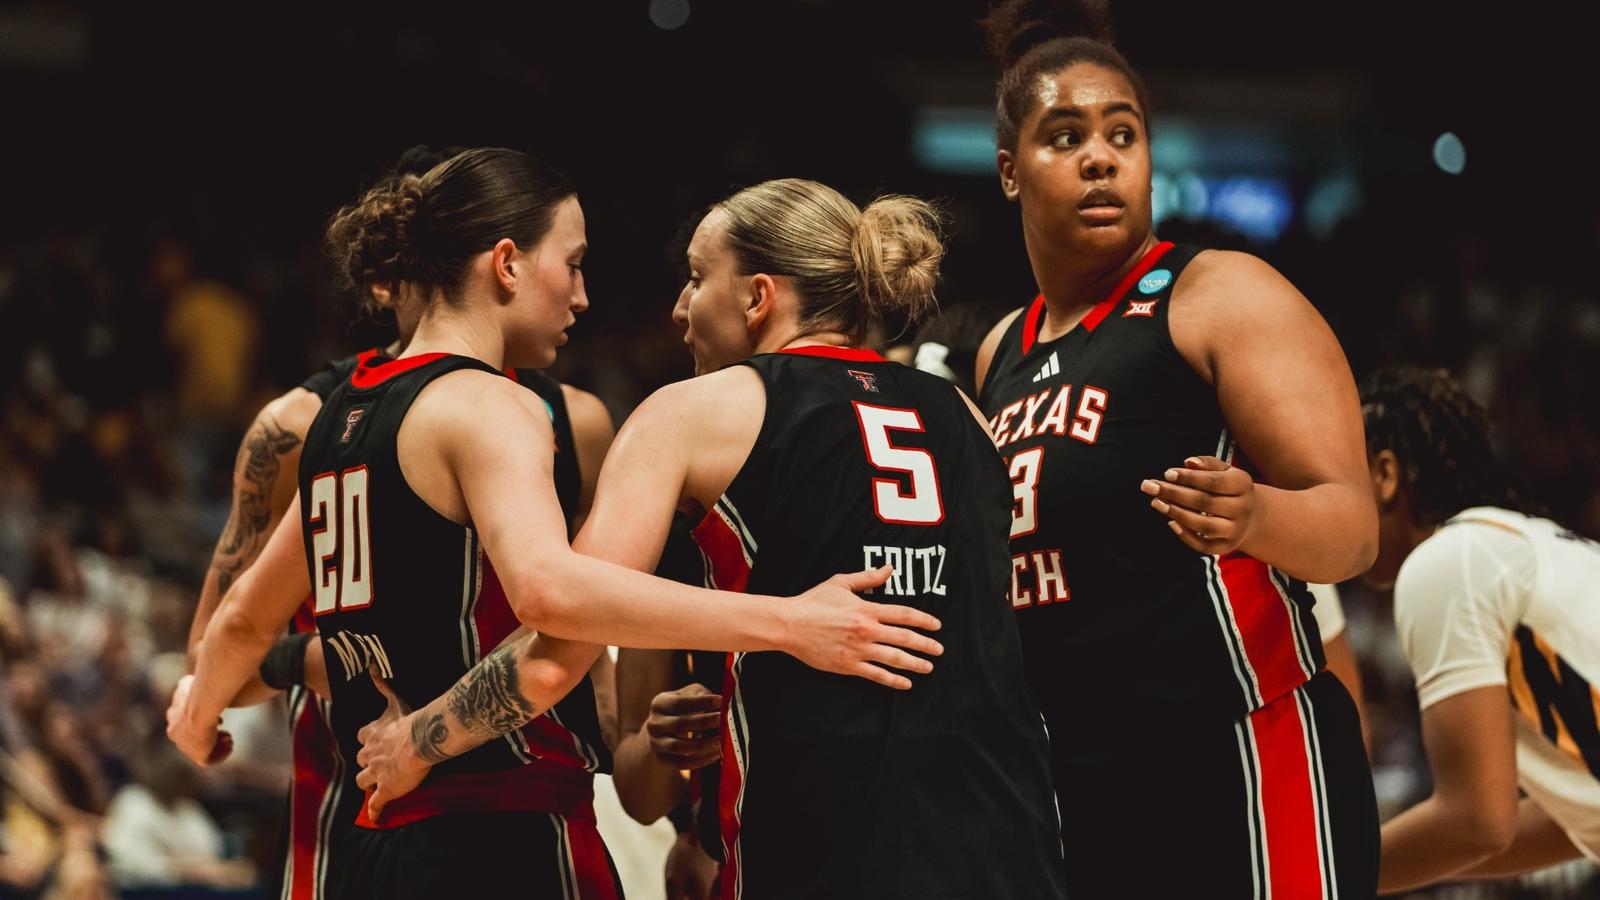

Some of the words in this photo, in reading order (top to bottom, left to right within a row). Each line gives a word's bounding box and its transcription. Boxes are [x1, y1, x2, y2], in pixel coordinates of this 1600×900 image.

[988, 384, 1109, 449] EXAS
[851, 400, 945, 526] 5
[1003, 446, 1045, 540] 3
[309, 464, 374, 617] 20
[862, 544, 947, 597] FRITZ
[1006, 549, 1071, 610] CH
